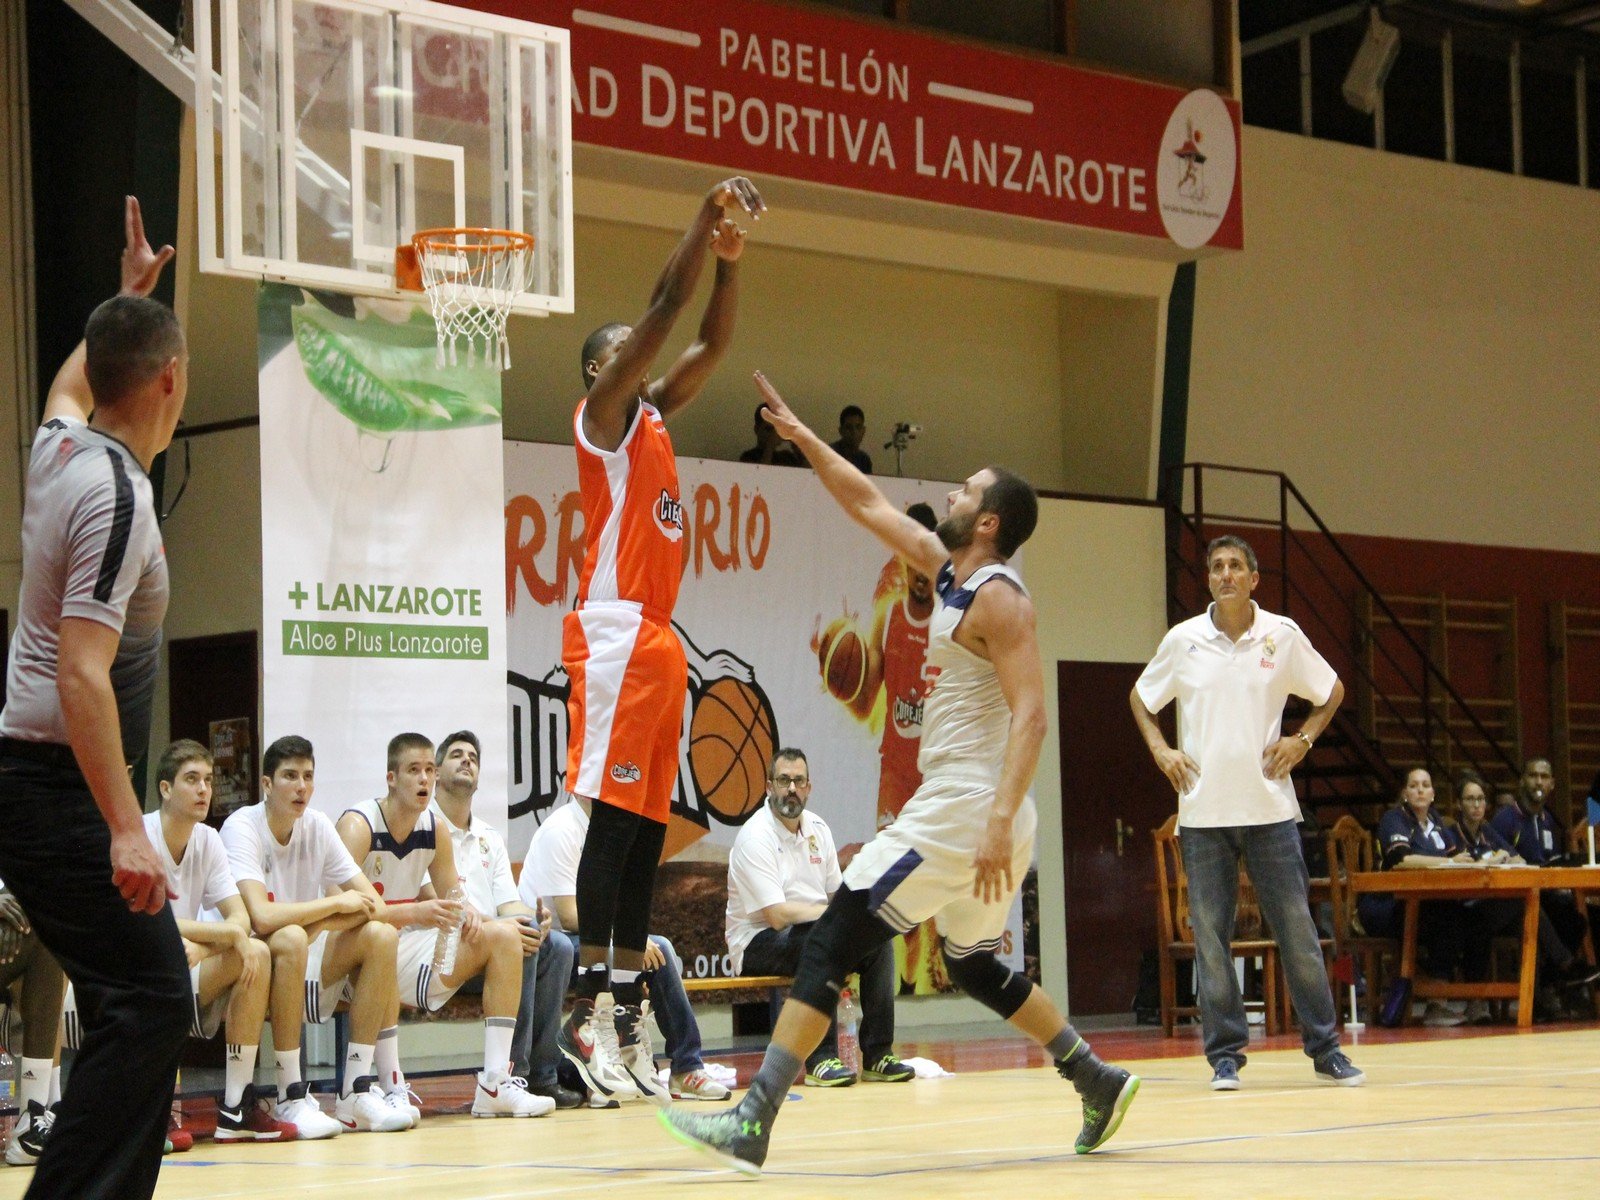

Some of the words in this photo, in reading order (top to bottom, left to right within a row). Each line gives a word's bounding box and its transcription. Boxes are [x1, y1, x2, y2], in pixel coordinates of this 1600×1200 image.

[720, 27, 909, 102] PABELLÓN
[641, 63, 896, 170] DEPORTIVA
[915, 116, 1147, 211] LANZAROTE
[289, 623, 337, 650] Aloe
[345, 627, 382, 653] Plus
[389, 631, 482, 655] Lanzarote
